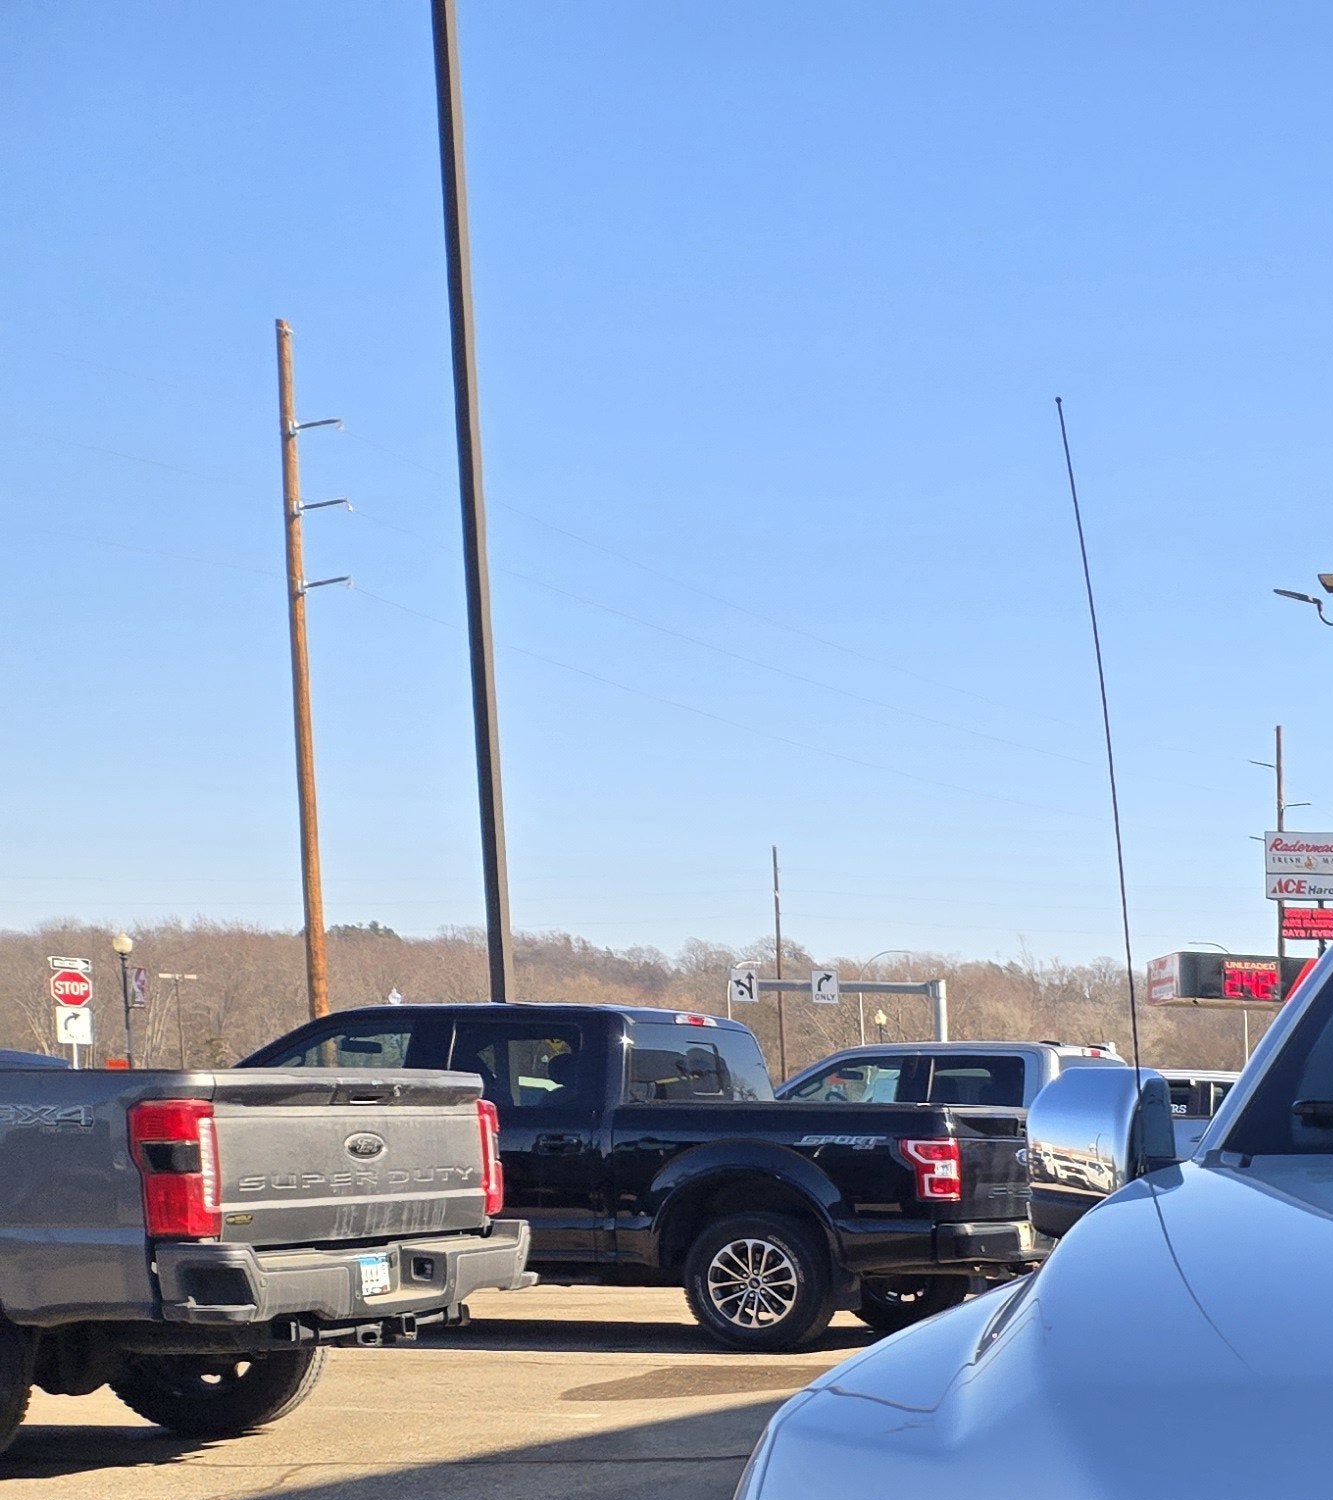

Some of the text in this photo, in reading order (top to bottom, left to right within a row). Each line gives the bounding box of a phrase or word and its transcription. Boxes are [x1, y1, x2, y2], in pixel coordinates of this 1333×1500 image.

[1271, 878, 1307, 894] ACE
[1225, 961, 1276, 970] UNLEADED
[54, 981, 89, 996] STOP
[815, 993, 836, 1001] ONLY
[793, 1134, 887, 1146] SPORT
[239, 1166, 474, 1192] SUPER DUTY
